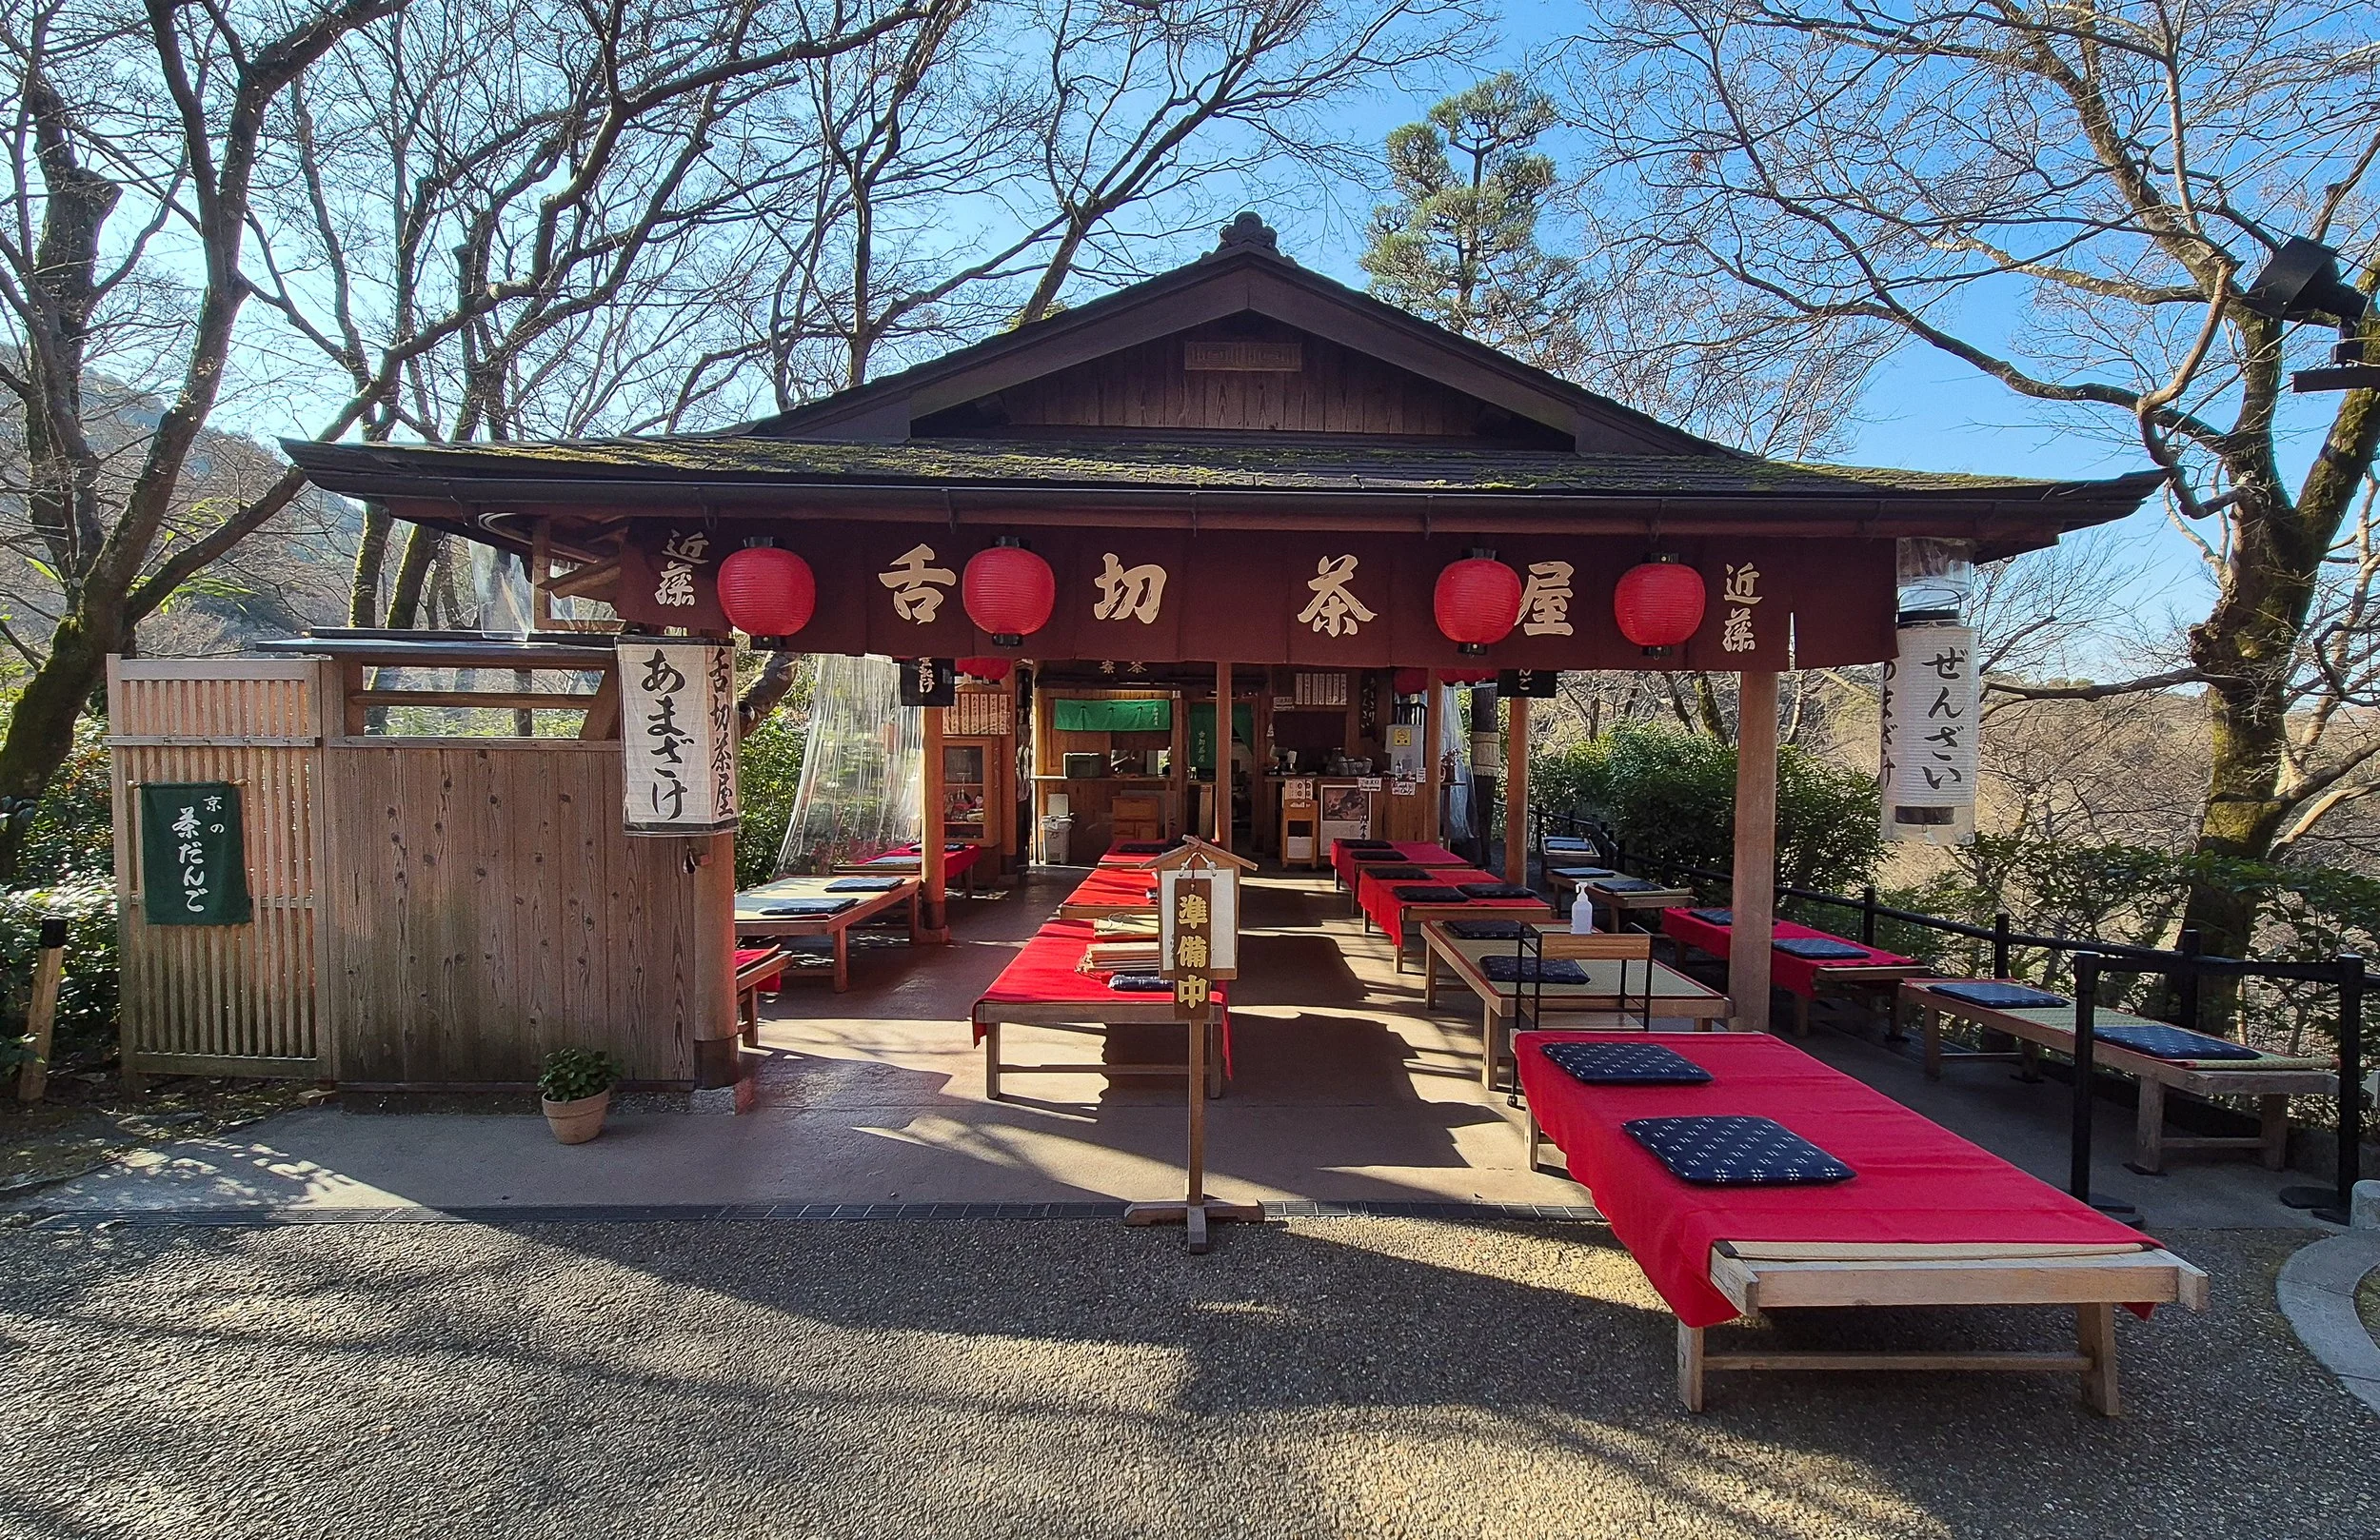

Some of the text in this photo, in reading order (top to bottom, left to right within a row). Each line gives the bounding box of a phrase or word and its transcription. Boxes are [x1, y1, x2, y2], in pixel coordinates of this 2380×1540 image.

[654, 529, 710, 607] 近藤
[878, 543, 1576, 637] 舌切茶屋
[1721, 562, 1764, 654] 近藤
[640, 647, 695, 820] あまざけ
[707, 646, 734, 818] 舌切茶屋
[1921, 646, 1969, 790] ぜんざい
[171, 805, 209, 913] 茶だんご
[203, 795, 225, 834] 京の
[1177, 894, 1208, 1009] 準備中
